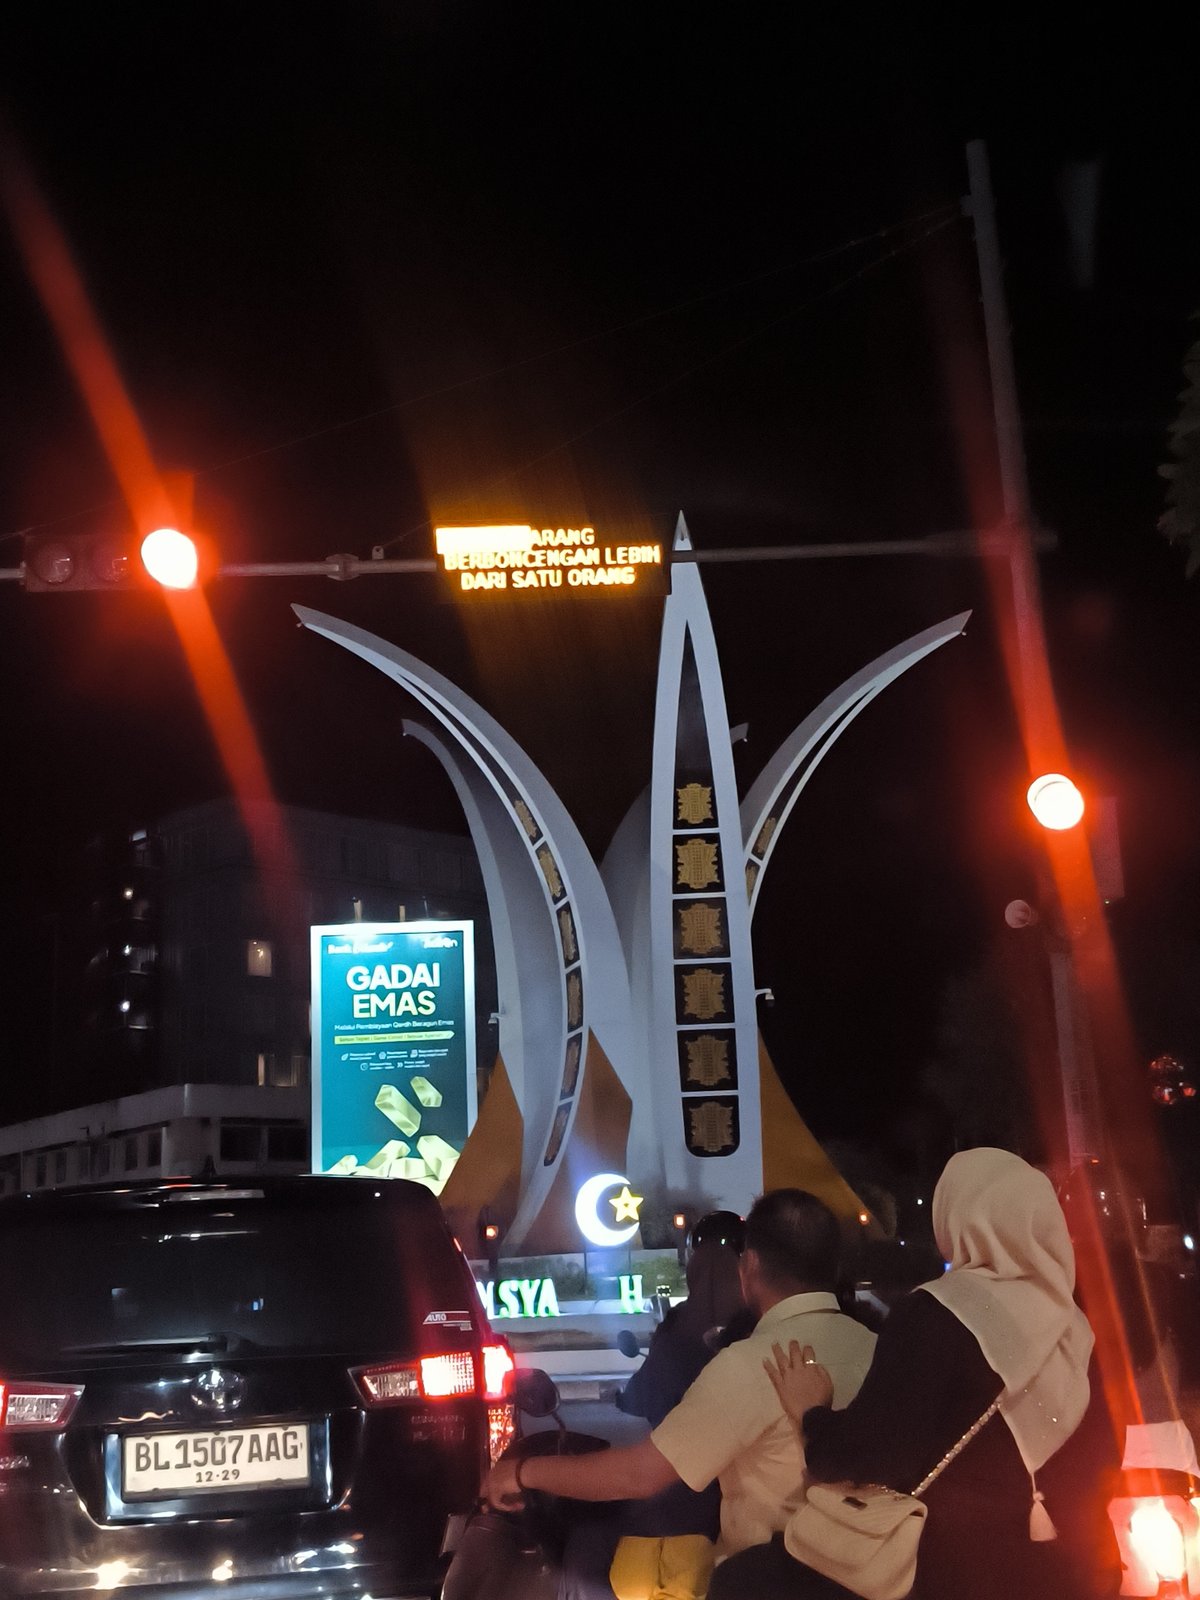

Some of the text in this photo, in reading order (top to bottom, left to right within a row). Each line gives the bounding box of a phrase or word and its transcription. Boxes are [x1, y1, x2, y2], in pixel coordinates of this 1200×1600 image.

[460, 566, 636, 590] DARI SATU ORANG
[346, 963, 441, 991] GADAI
[353, 991, 437, 1019] EMAS
[135, 1431, 299, 1472] BL 1507 AAG
